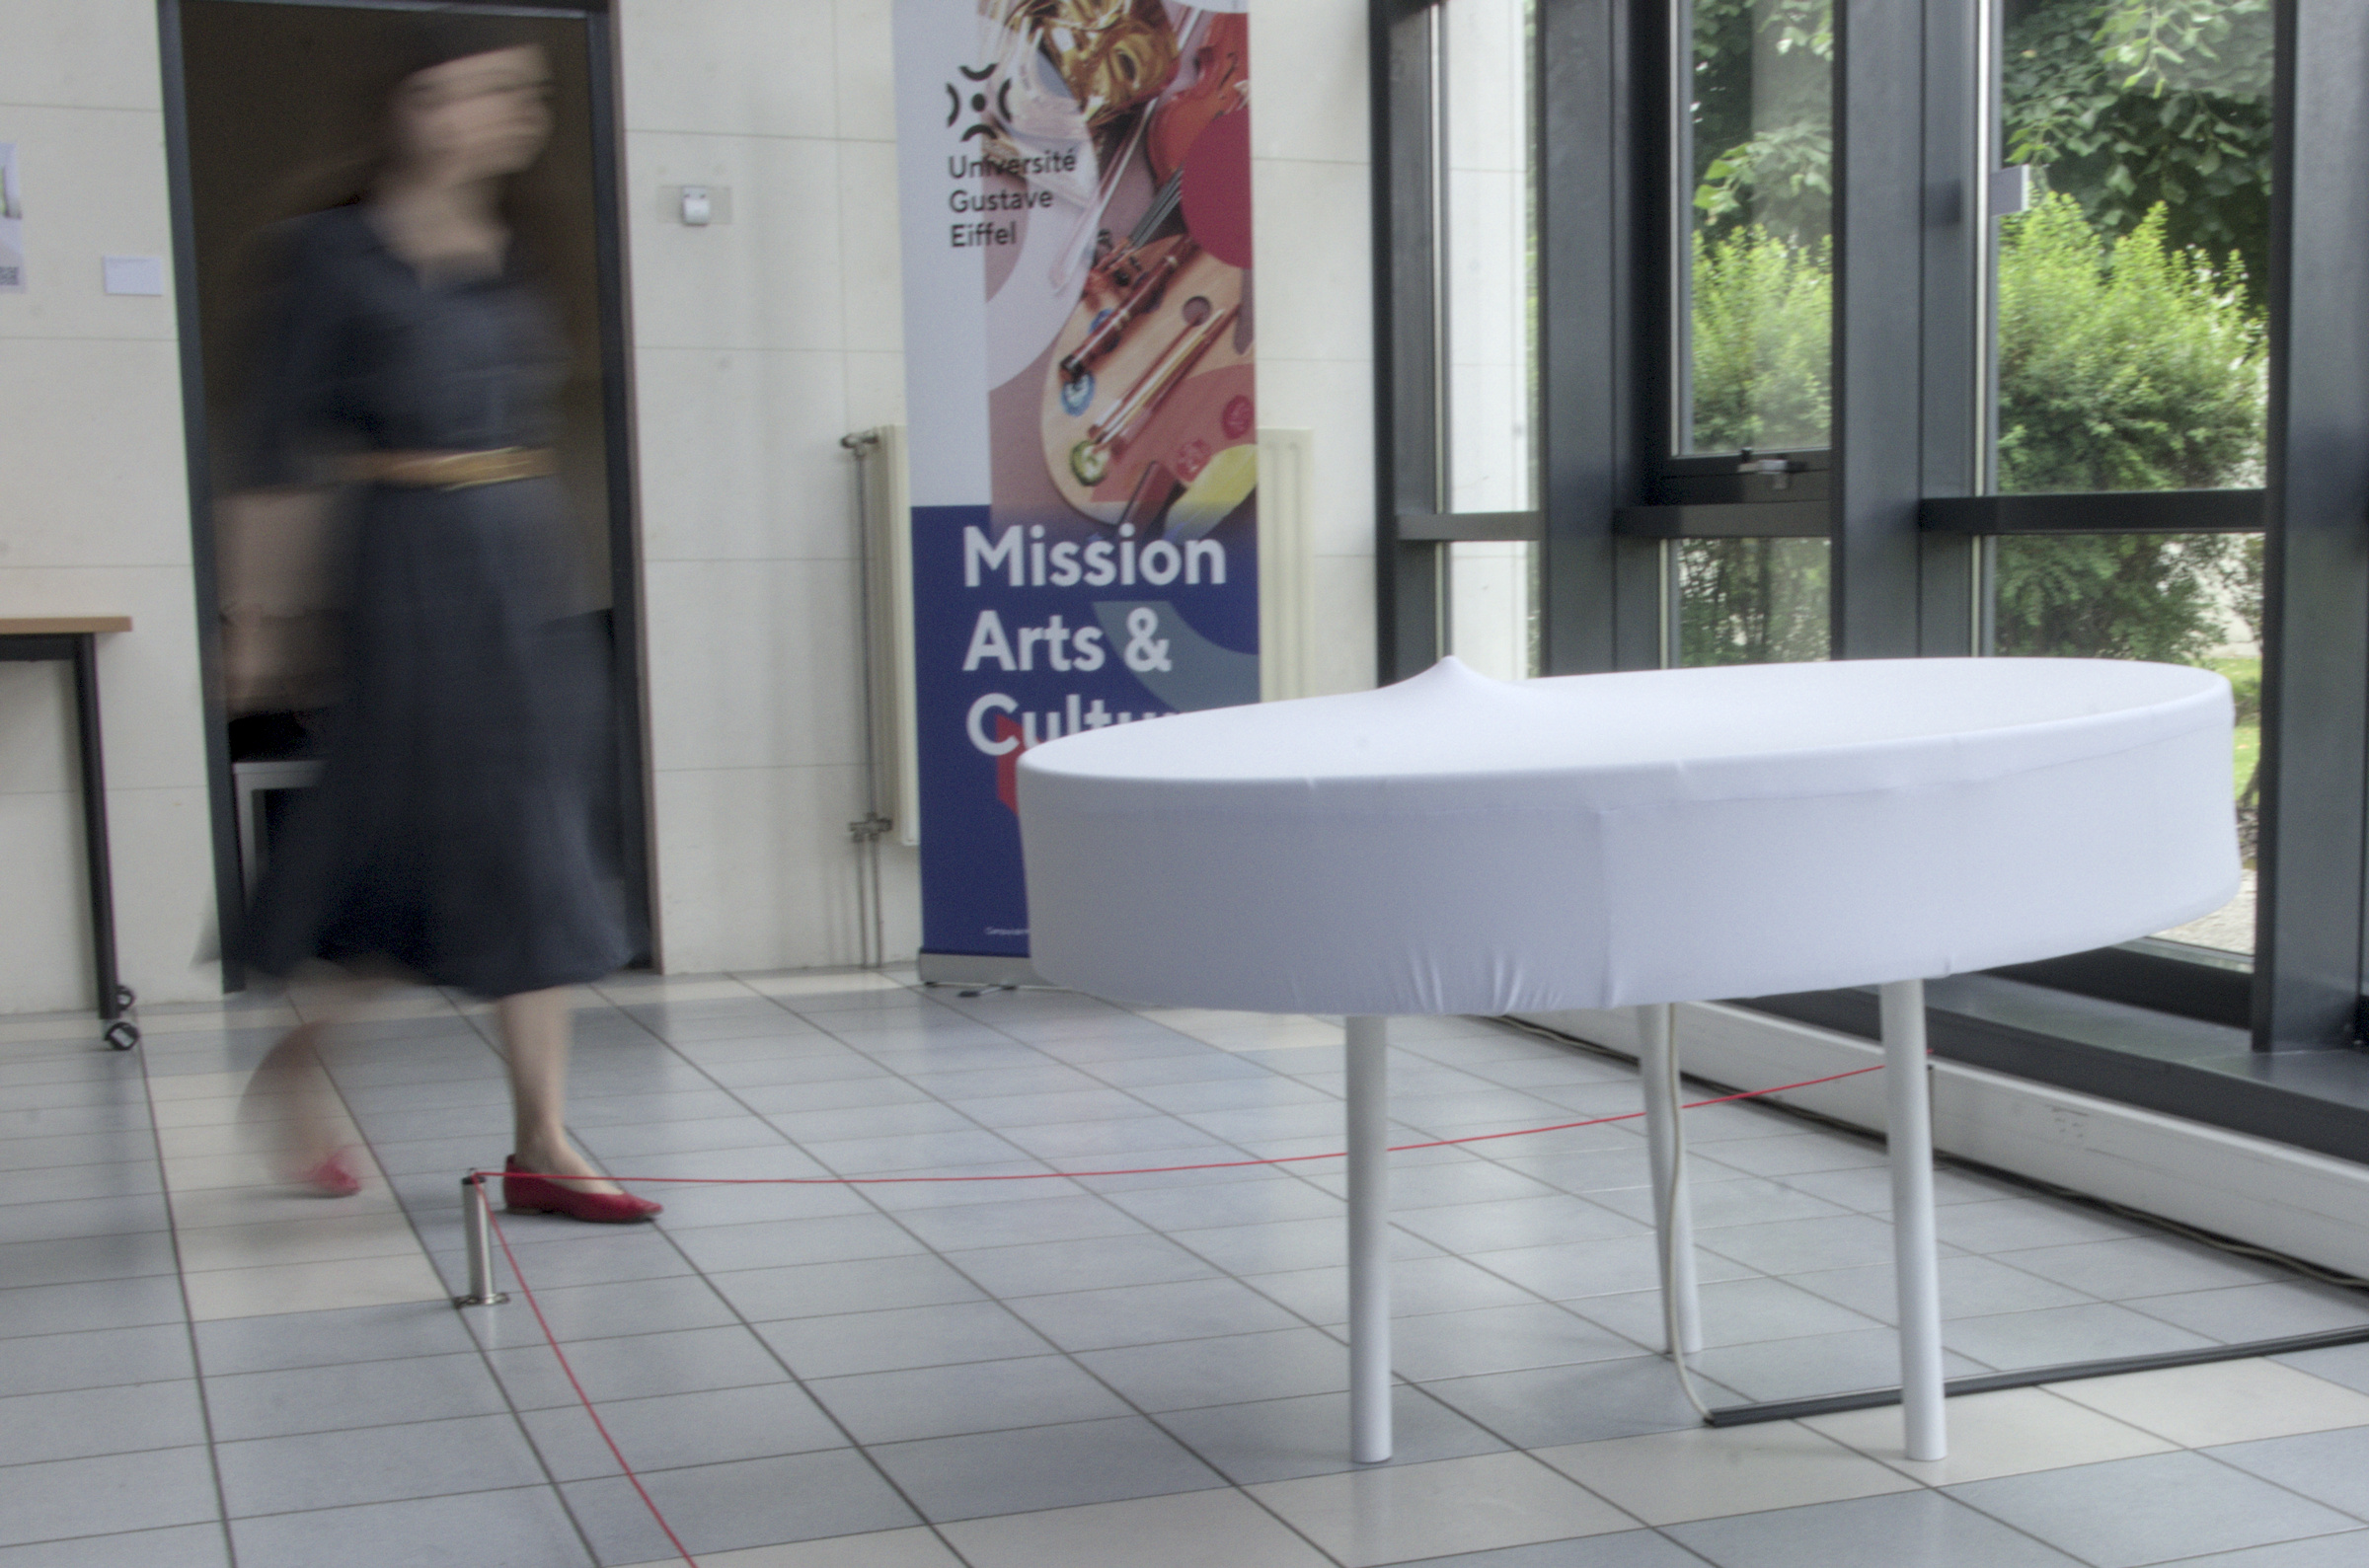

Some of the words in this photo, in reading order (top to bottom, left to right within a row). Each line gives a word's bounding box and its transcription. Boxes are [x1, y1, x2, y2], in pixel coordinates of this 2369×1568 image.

[948, 148, 1077, 179] Université
[949, 189, 1054, 213] Gustave
[951, 221, 1017, 248] Eiffel
[962, 523, 1227, 588] Mission
[961, 609, 1107, 672] Arts
[1123, 606, 1173, 673] &
[965, 693, 1183, 757] Cult
